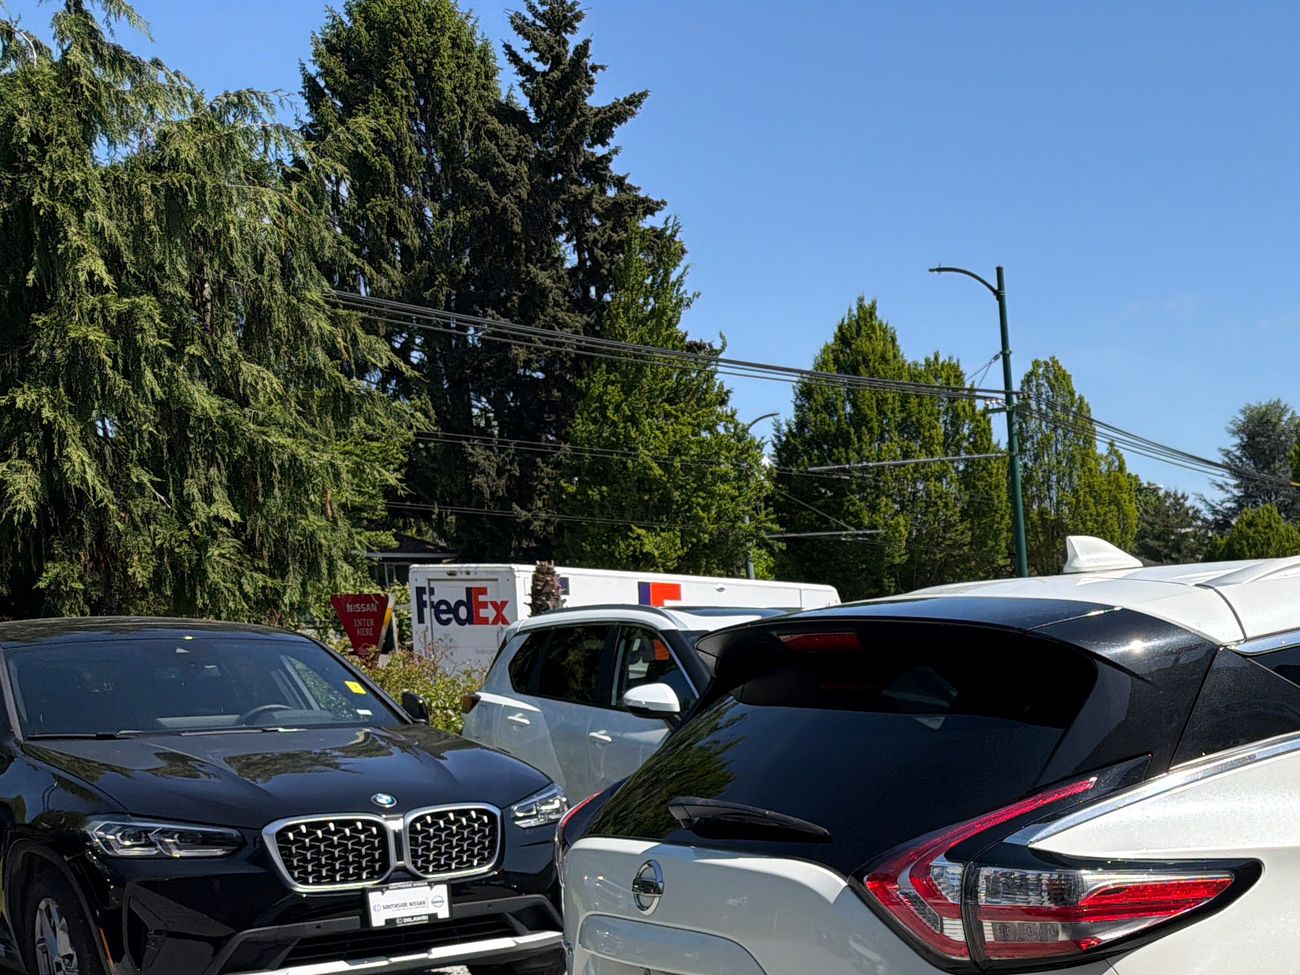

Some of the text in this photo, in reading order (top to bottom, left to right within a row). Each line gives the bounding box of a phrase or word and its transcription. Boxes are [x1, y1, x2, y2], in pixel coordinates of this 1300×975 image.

[346, 603, 378, 613] NISSAN
[415, 586, 511, 627] FedEx
[353, 618, 375, 627] ENTER
[356, 627, 374, 637] HERE
